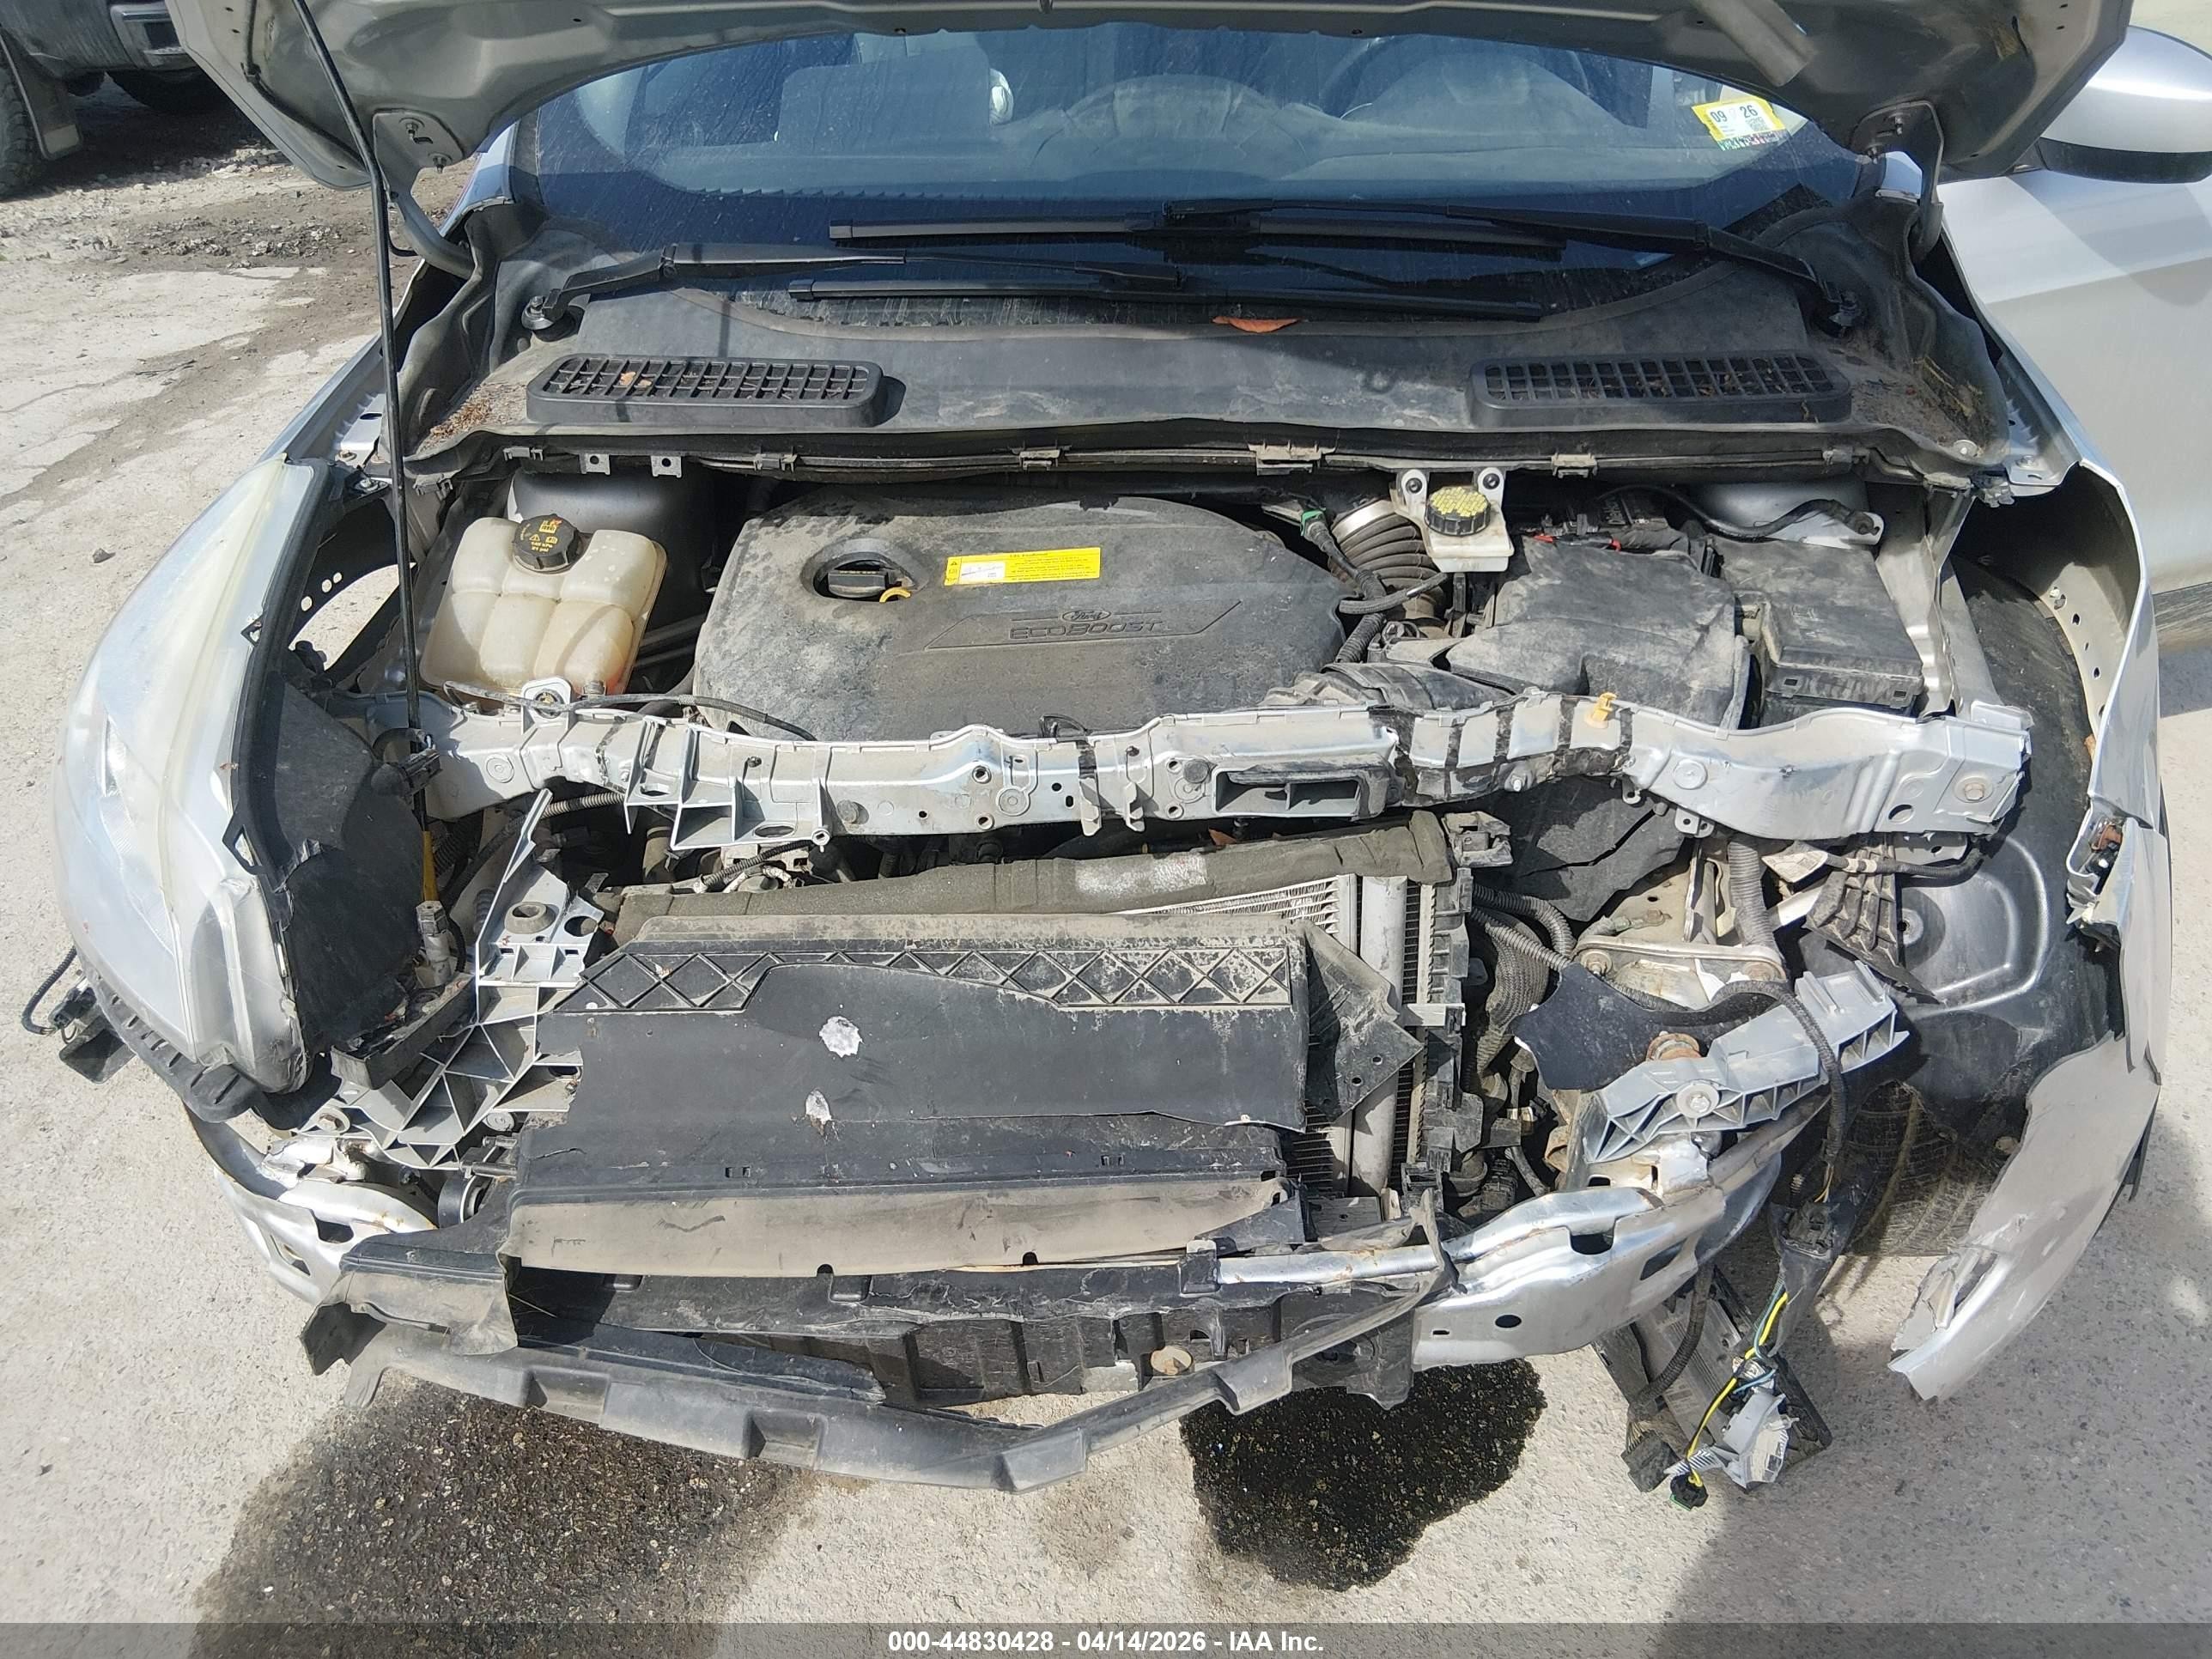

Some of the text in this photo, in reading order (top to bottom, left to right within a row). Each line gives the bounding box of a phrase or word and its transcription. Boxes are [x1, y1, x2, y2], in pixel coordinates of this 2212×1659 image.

[1711, 110, 1728, 123] 09
[1740, 105, 1759, 118] 26
[1010, 621, 1163, 640] ECOBOOST
